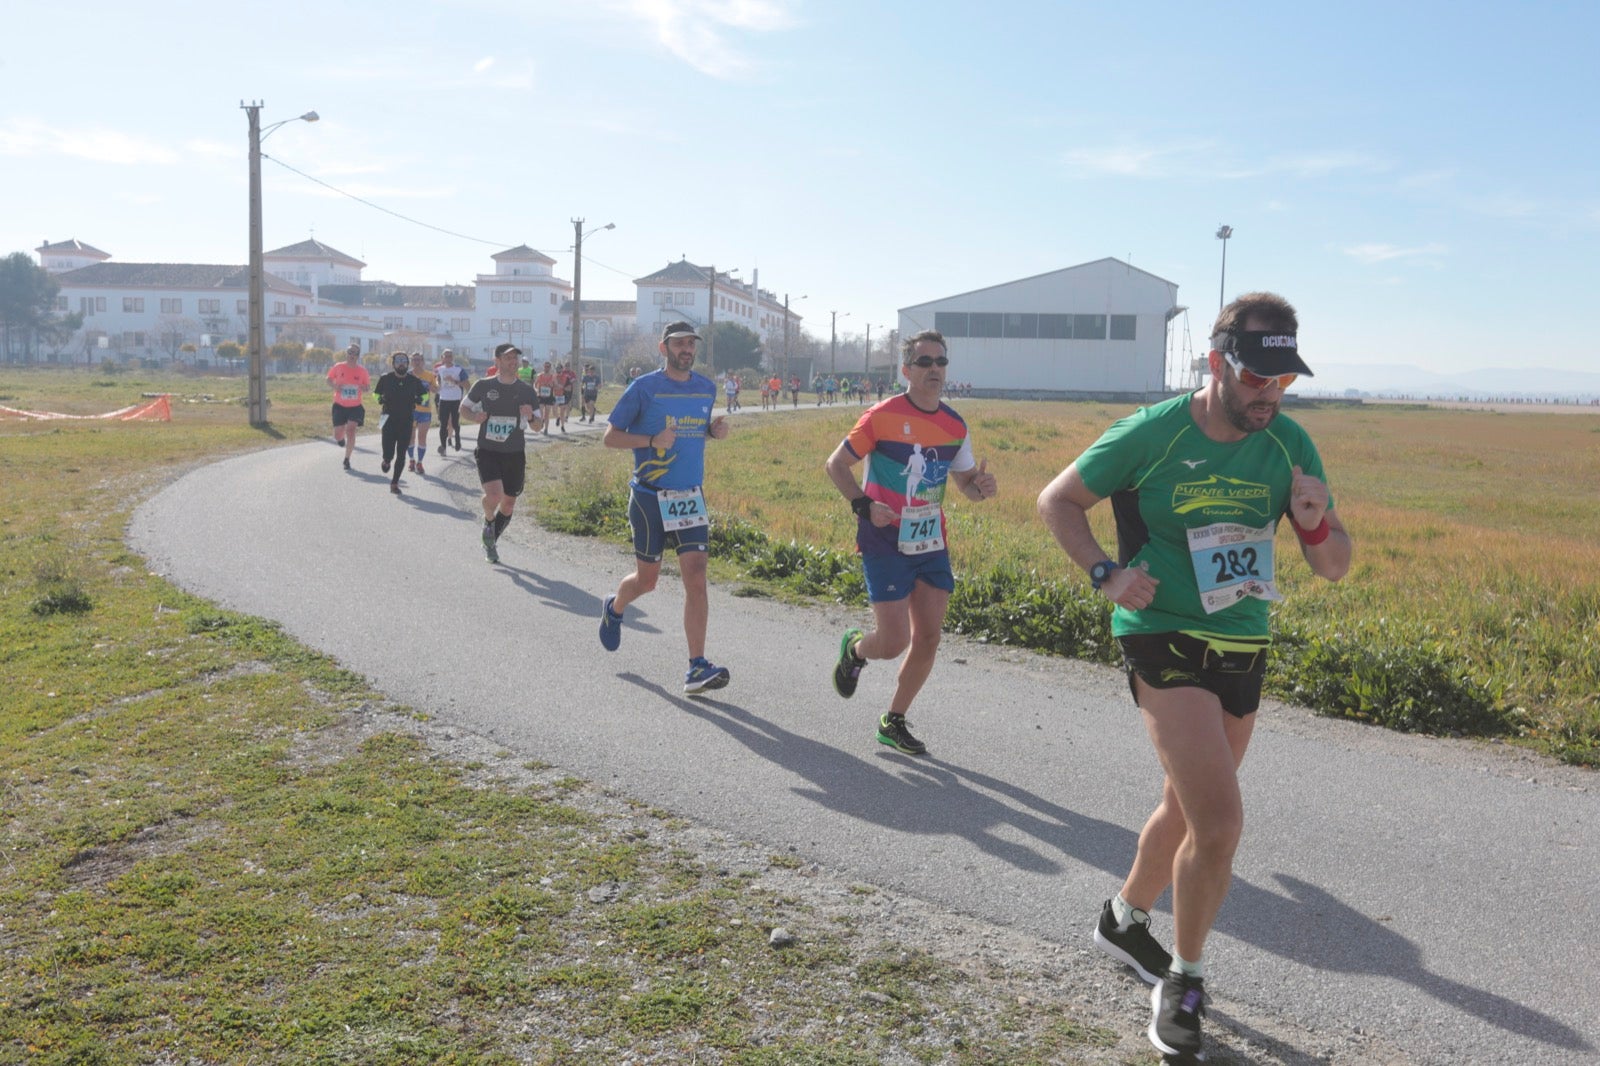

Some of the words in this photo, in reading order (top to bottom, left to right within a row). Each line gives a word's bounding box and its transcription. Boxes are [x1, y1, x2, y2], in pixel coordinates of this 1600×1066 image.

[489, 423, 514, 434] 1012
[1175, 485, 1226, 498] PUENTE
[1228, 486, 1270, 498] VERDE
[668, 499, 699, 517] 422
[1202, 507, 1244, 516] Granada
[910, 518, 936, 540] 747
[1211, 547, 1260, 584] 282
